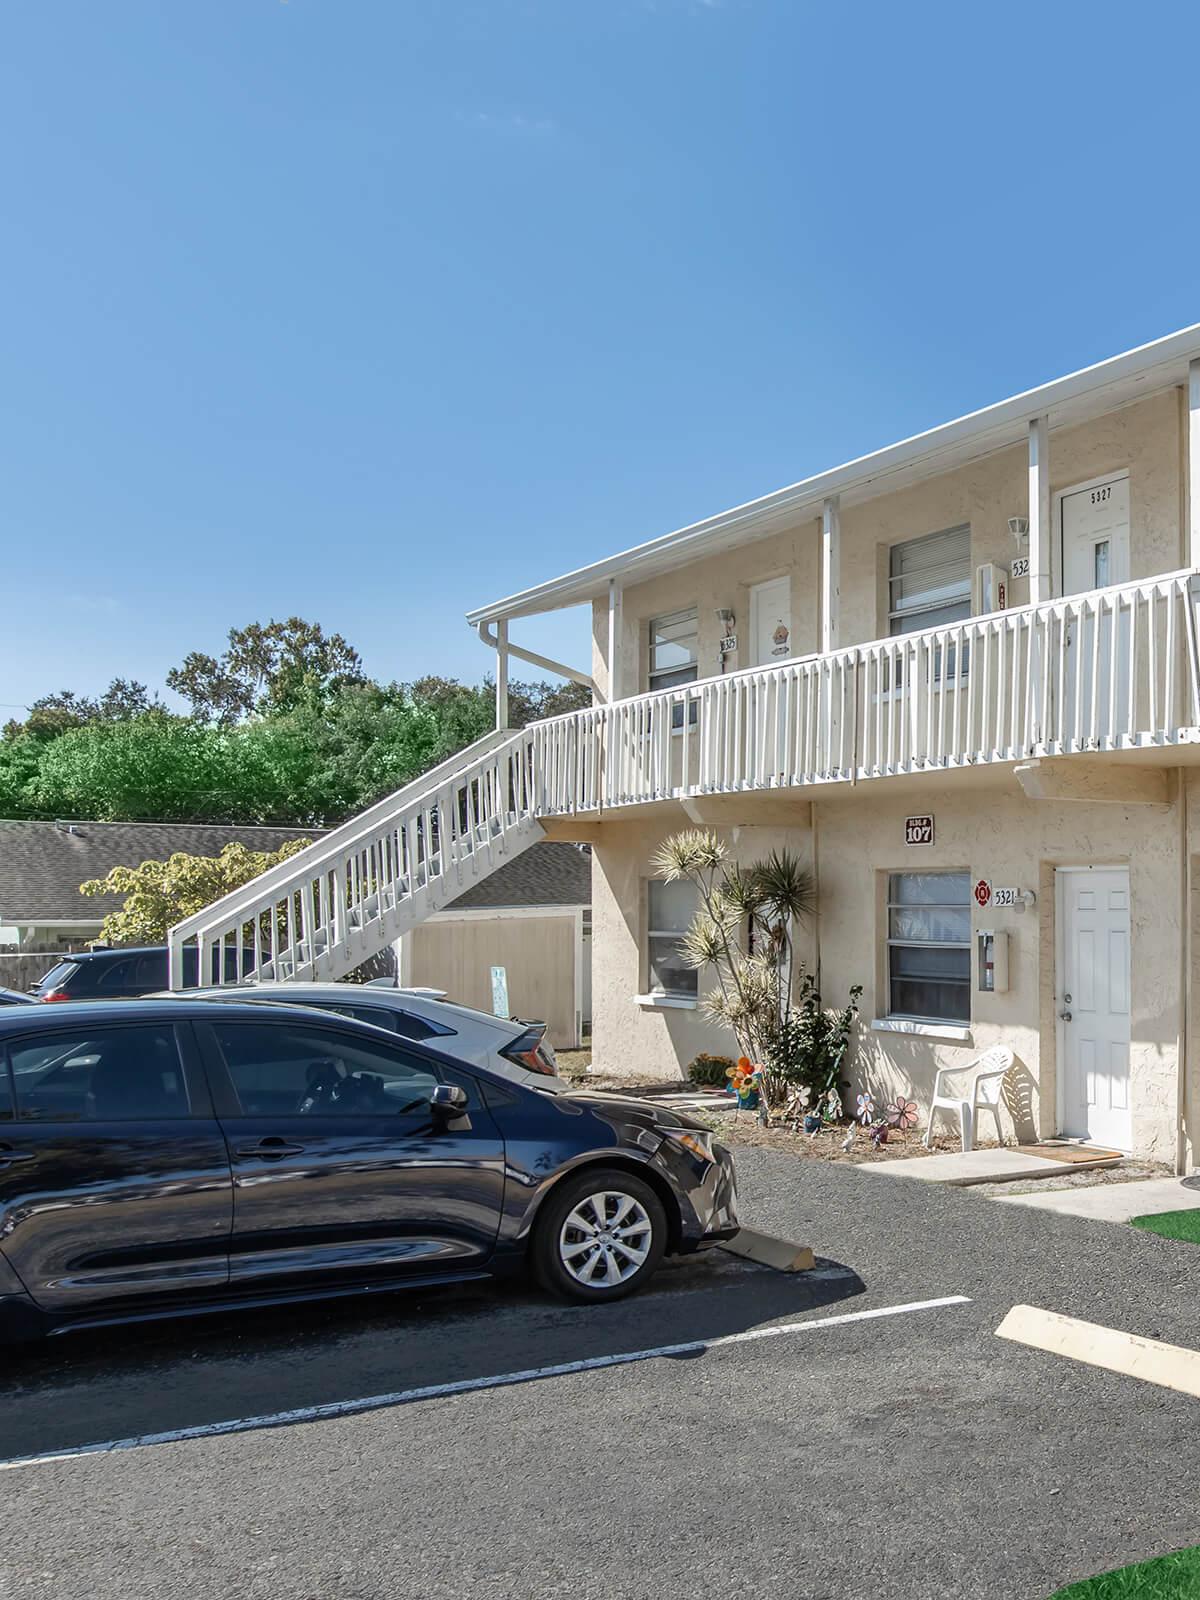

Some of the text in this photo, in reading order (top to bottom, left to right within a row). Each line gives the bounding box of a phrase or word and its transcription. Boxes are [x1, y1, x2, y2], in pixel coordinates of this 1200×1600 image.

[1091, 487, 1112, 504] 5327
[1012, 559, 1029, 577] 532
[907, 826, 931, 842] 107
[995, 889, 1015, 905] 5321
